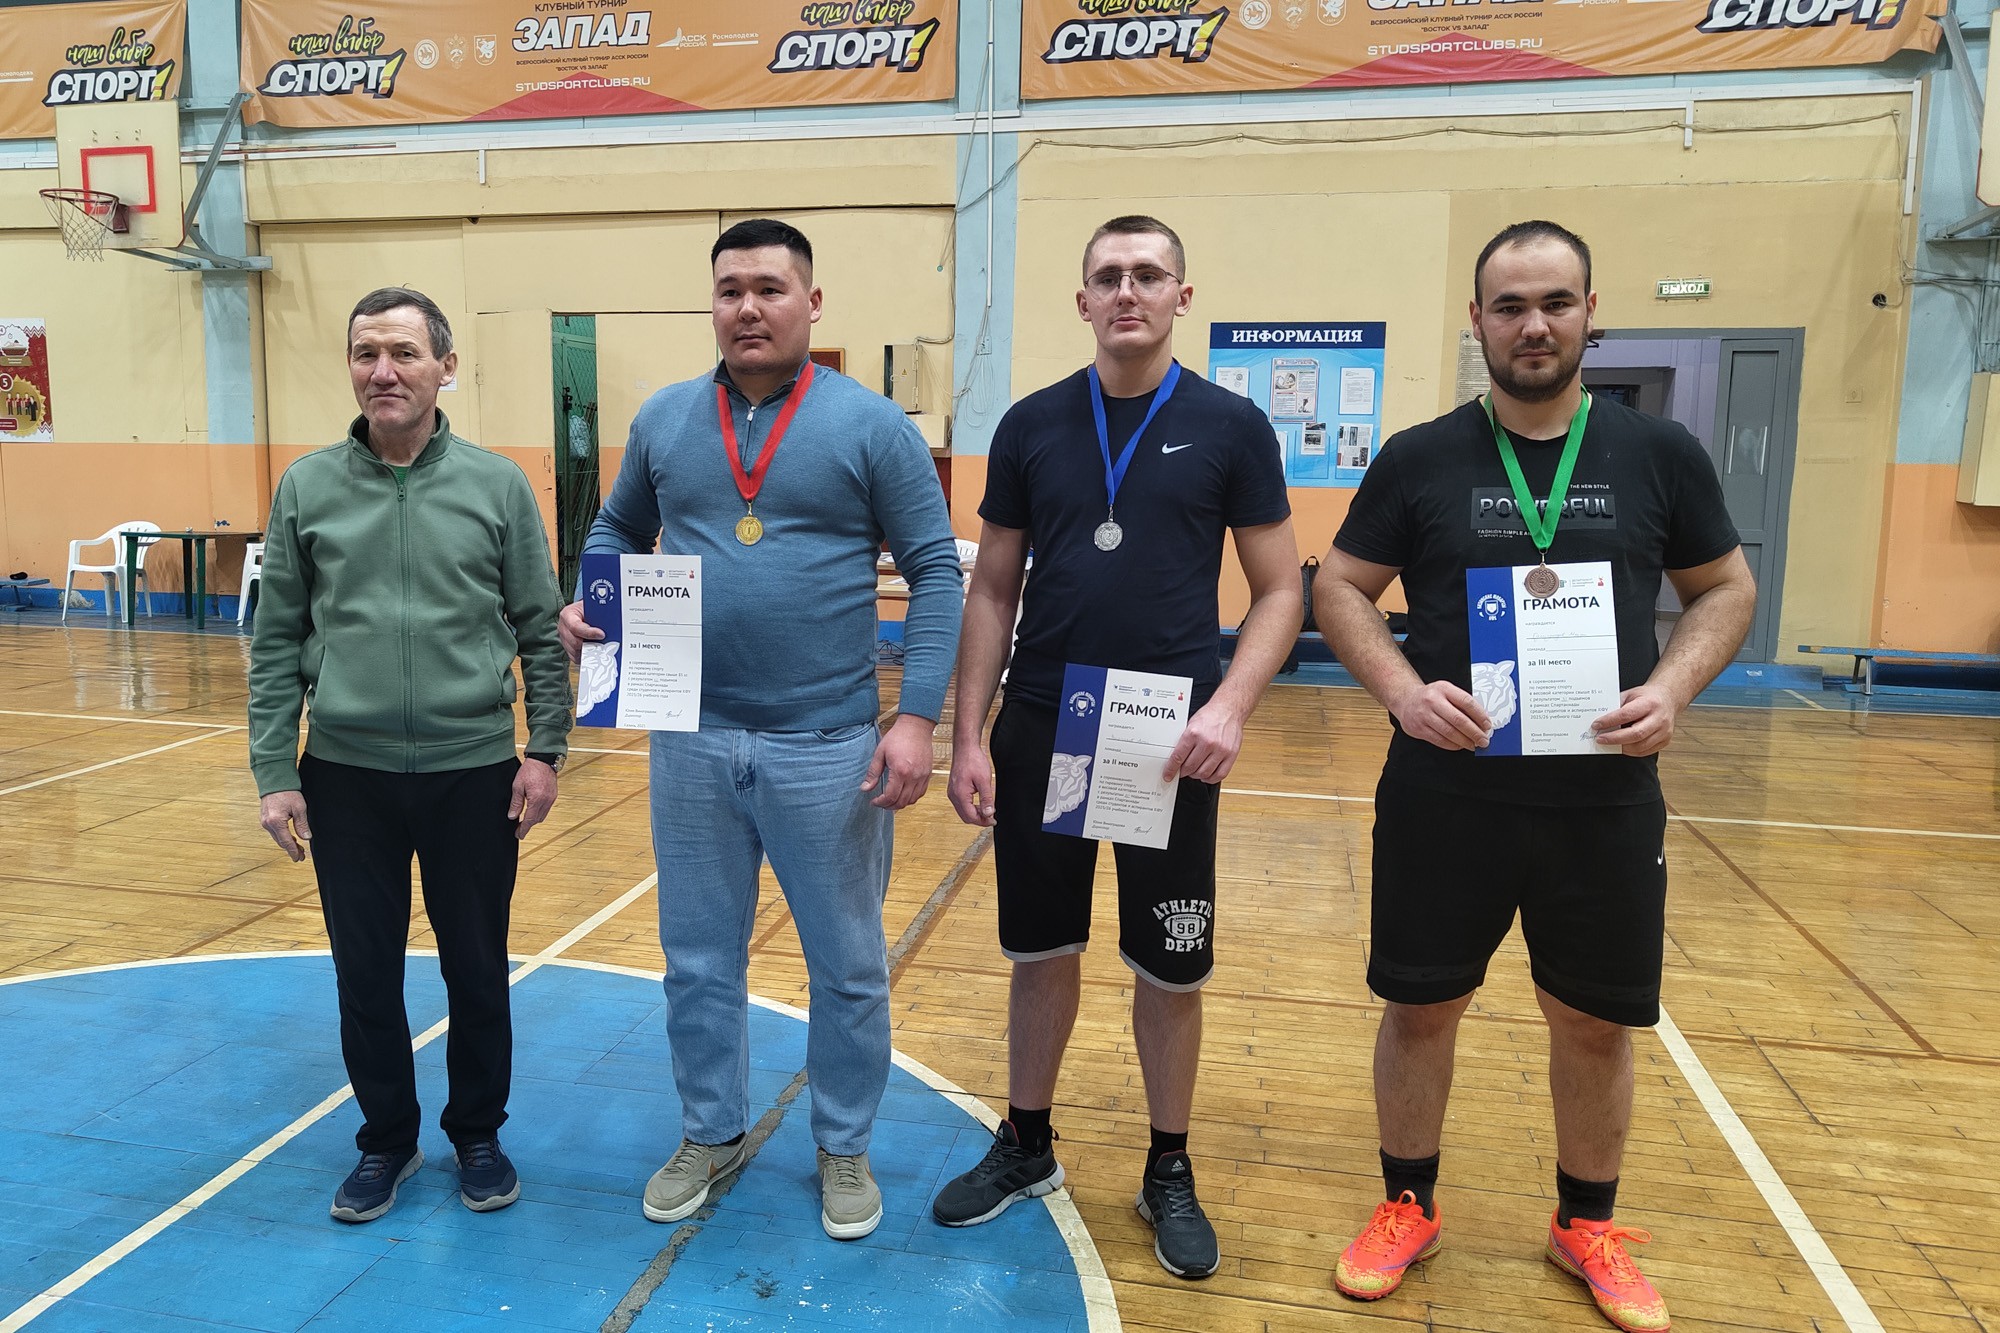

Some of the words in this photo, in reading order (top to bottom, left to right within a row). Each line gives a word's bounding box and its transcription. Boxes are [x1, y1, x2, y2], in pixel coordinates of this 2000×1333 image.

[535, 0, 584, 12] КЛУБНЫЙ
[1370, 16, 1429, 25] ВСЕРОССИЙСКИЙ
[1430, 15, 1464, 23] КЛУБНЫЙ
[289, 33, 331, 57] наш
[333, 15, 384, 56] выбор
[512, 11, 652, 51] ЗАПАД
[681, 34, 707, 42] АССК
[1041, 7, 1229, 63] СПОРТ!
[66, 45, 106, 67] наш
[107, 27, 155, 66] выбор
[768, 18, 939, 72] СПОРТ!
[1368, 38, 1543, 55] STUDSPORTCLUBS.RU
[258, 49, 406, 97] СПОРТ!
[43, 60, 174, 104] СПОРТ!
[515, 77, 651, 91] STUDSPORTCLUBS.RU
[1662, 284, 1705, 294] ВЫХОД
[1231, 330, 1363, 343] ИНФОРМАЦИЯ
[2, 378, 8, 387] 5
[628, 586, 690, 598] ГРАМОТА
[1523, 596, 1600, 611] ГРАМОТА
[1109, 702, 1176, 720] ГРАМОТА
[1177, 923, 1195, 934] 98
[1165, 937, 1207, 952] DEPT.
